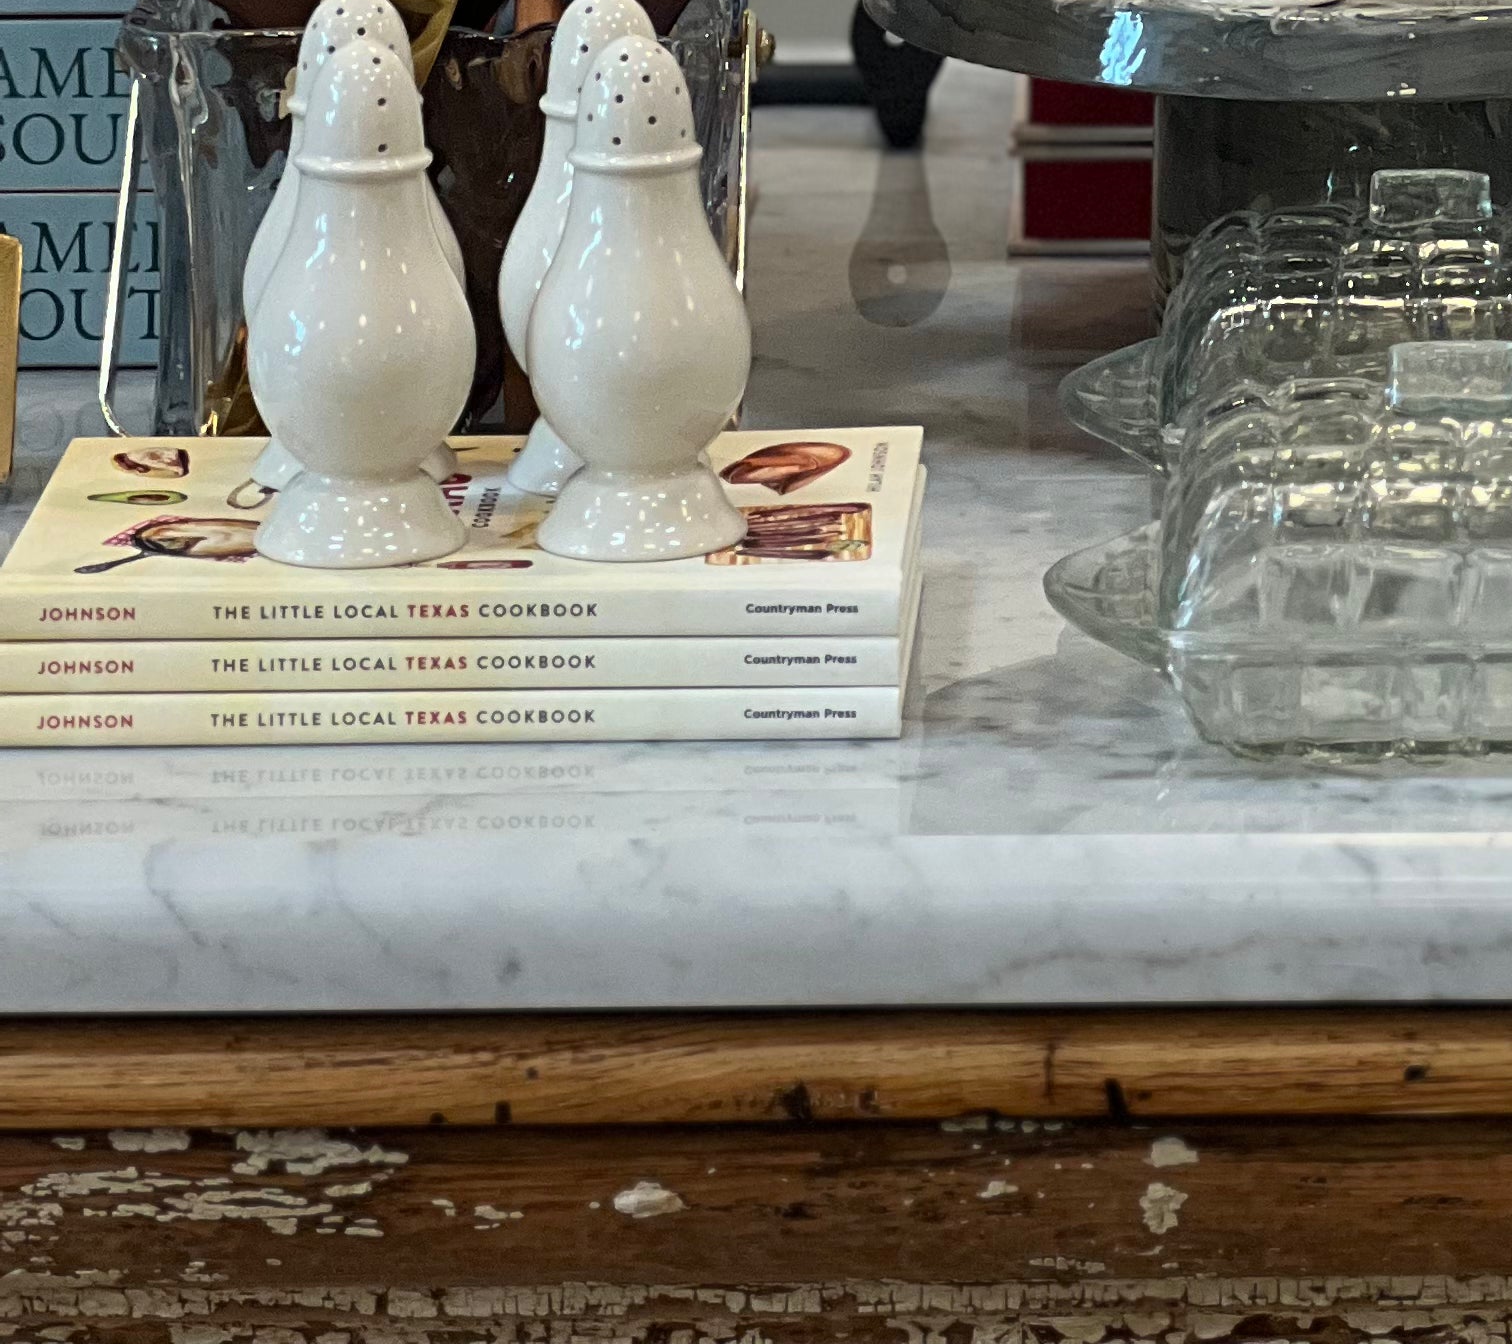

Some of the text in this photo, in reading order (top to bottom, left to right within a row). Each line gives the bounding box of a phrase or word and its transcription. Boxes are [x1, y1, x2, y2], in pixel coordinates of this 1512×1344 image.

[39, 607, 136, 622] JOHNSON
[212, 603, 598, 620] THE LITTLE LOCAL TEXAS COOKBOOK
[745, 603, 859, 615] Countryman Press
[37, 660, 135, 675] JOHNSON
[211, 655, 597, 673] THE LITTLE LOCAL TEXAS COOKBOOK
[744, 654, 857, 666] Countryman Press
[36, 714, 134, 730] JOHNSON
[210, 709, 596, 728] THE LITTLE LOCAL TEXAS COOKBOOK
[743, 708, 857, 721] Countryman Press
